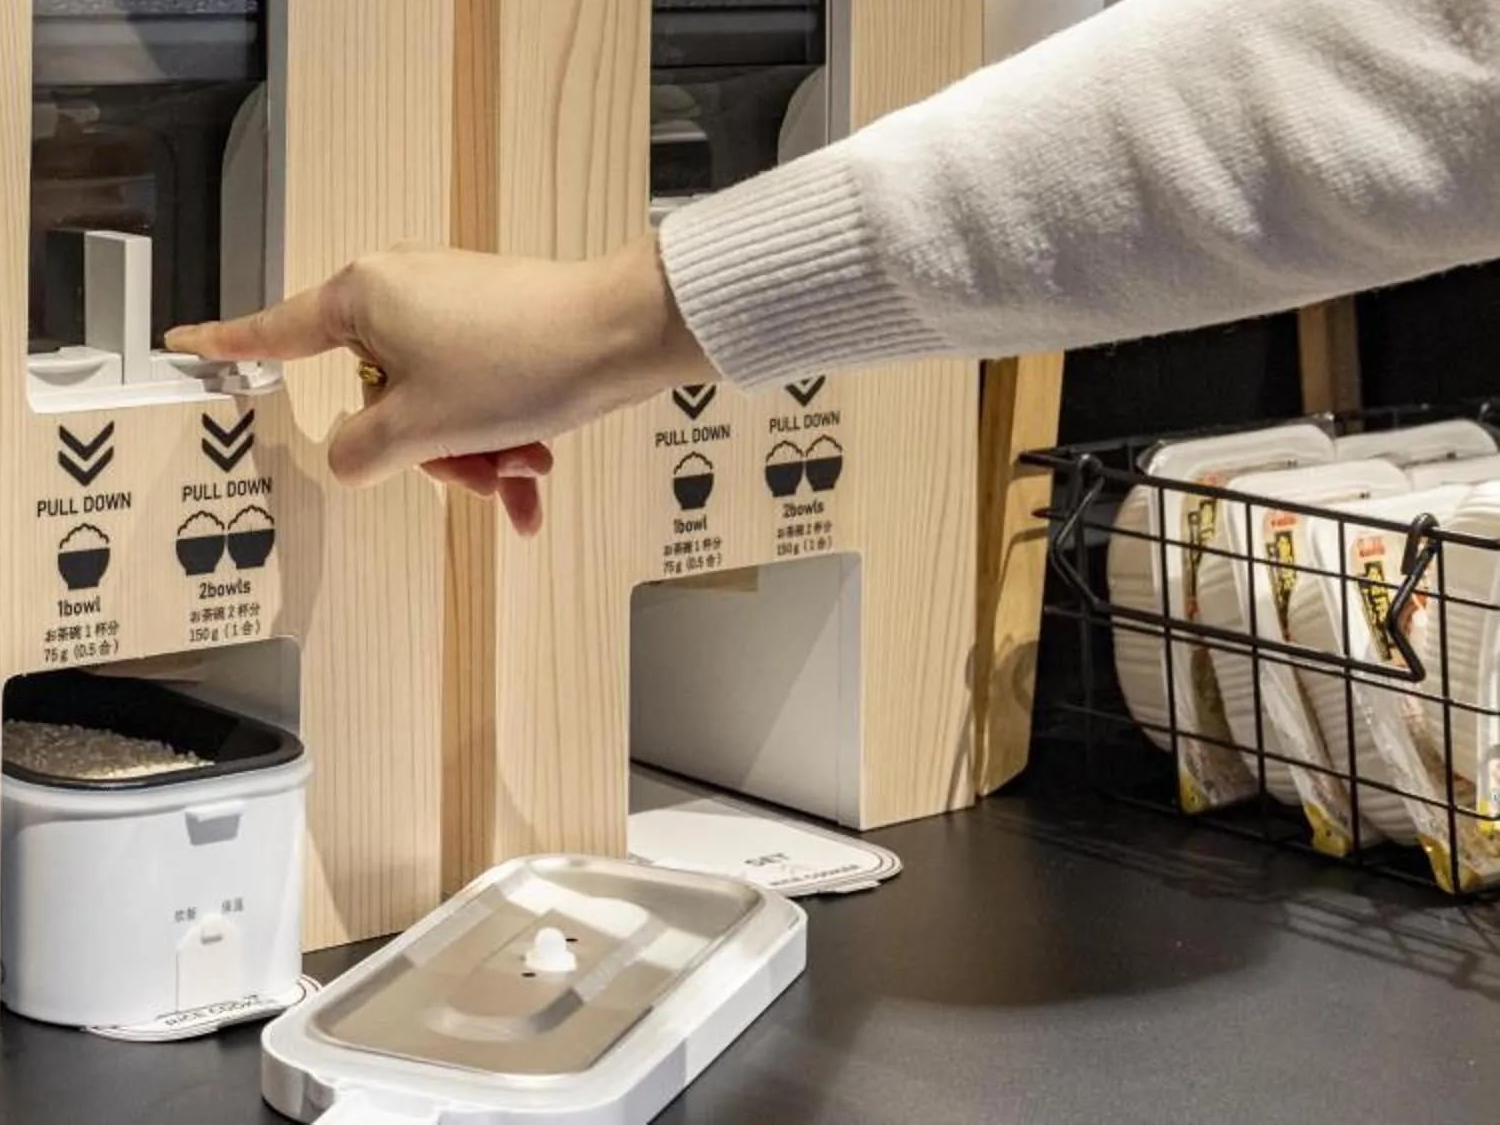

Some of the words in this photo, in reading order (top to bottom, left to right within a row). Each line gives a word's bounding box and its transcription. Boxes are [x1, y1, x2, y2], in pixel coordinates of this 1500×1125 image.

[769, 416, 801, 434] PULL
[804, 411, 841, 428] DOWN
[655, 431, 688, 448] PULL
[692, 424, 731, 444] DOWN
[182, 483, 221, 502] PULL
[226, 477, 273, 498] DOWN
[37, 499, 78, 517] PULL
[83, 492, 132, 514] DOWN
[673, 515, 708, 534] 1bowl
[199, 578, 251, 599] 2bowls
[58, 596, 101, 617] 1bowl
